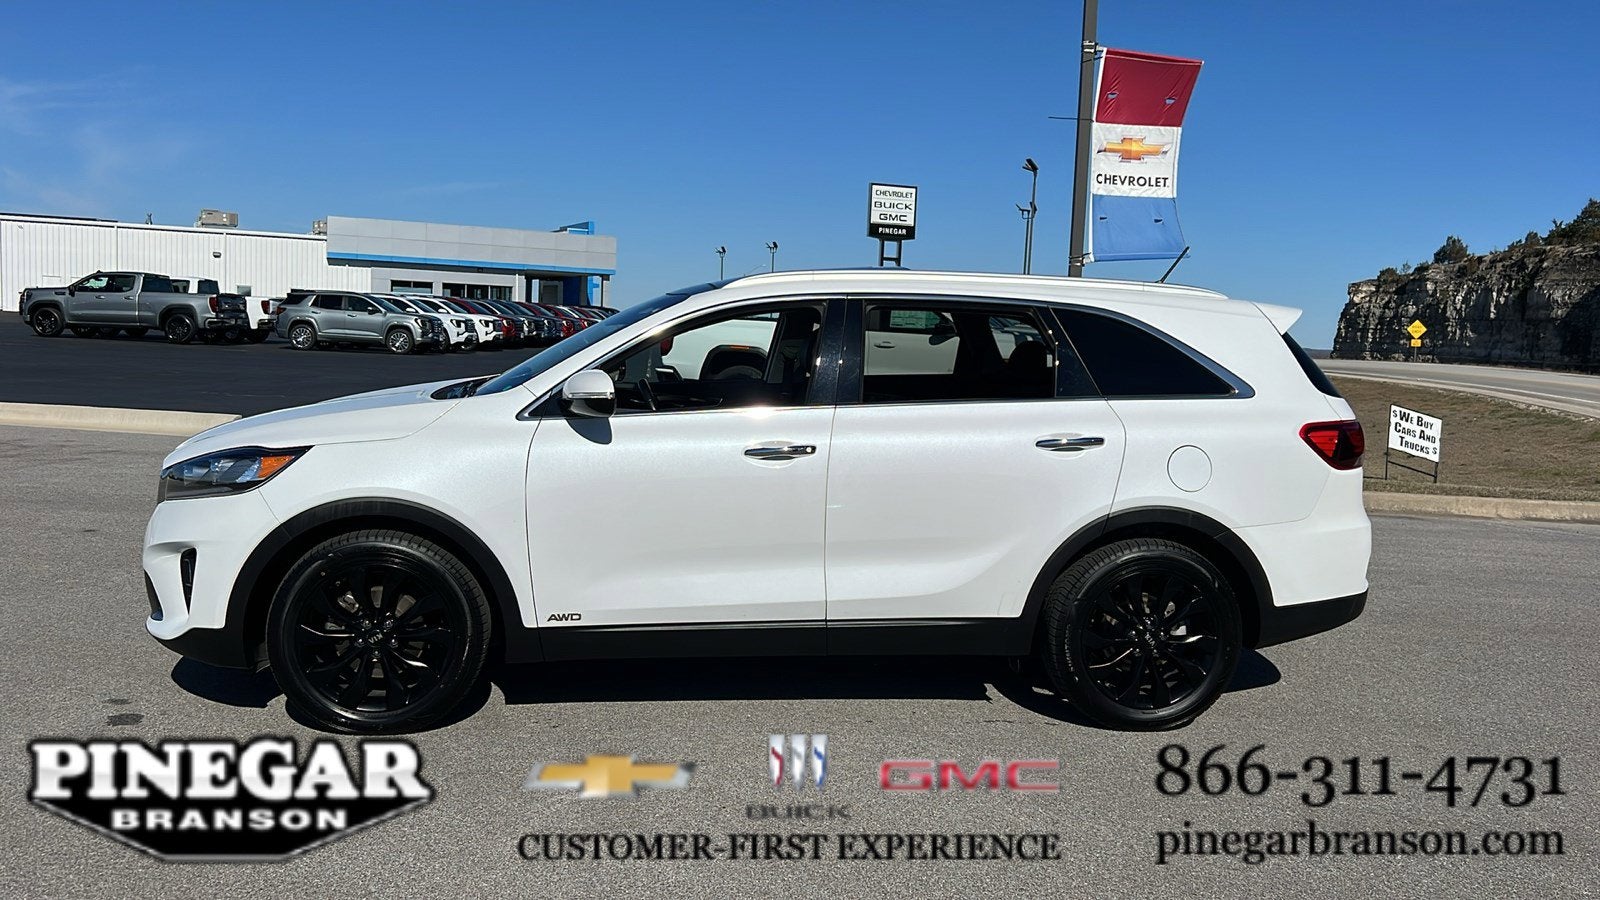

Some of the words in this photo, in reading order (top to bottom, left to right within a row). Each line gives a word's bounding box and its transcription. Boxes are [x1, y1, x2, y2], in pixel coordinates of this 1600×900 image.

[1096, 173, 1169, 188] CHEVROLET
[875, 189, 914, 199] CHEVROLET
[874, 201, 913, 211] BUICK
[879, 213, 907, 222] GMC
[878, 227, 907, 235] PINEGAR
[547, 613, 582, 622] AWD
[367, 632, 384, 644] KIA
[1144, 631, 1156, 646] KIA
